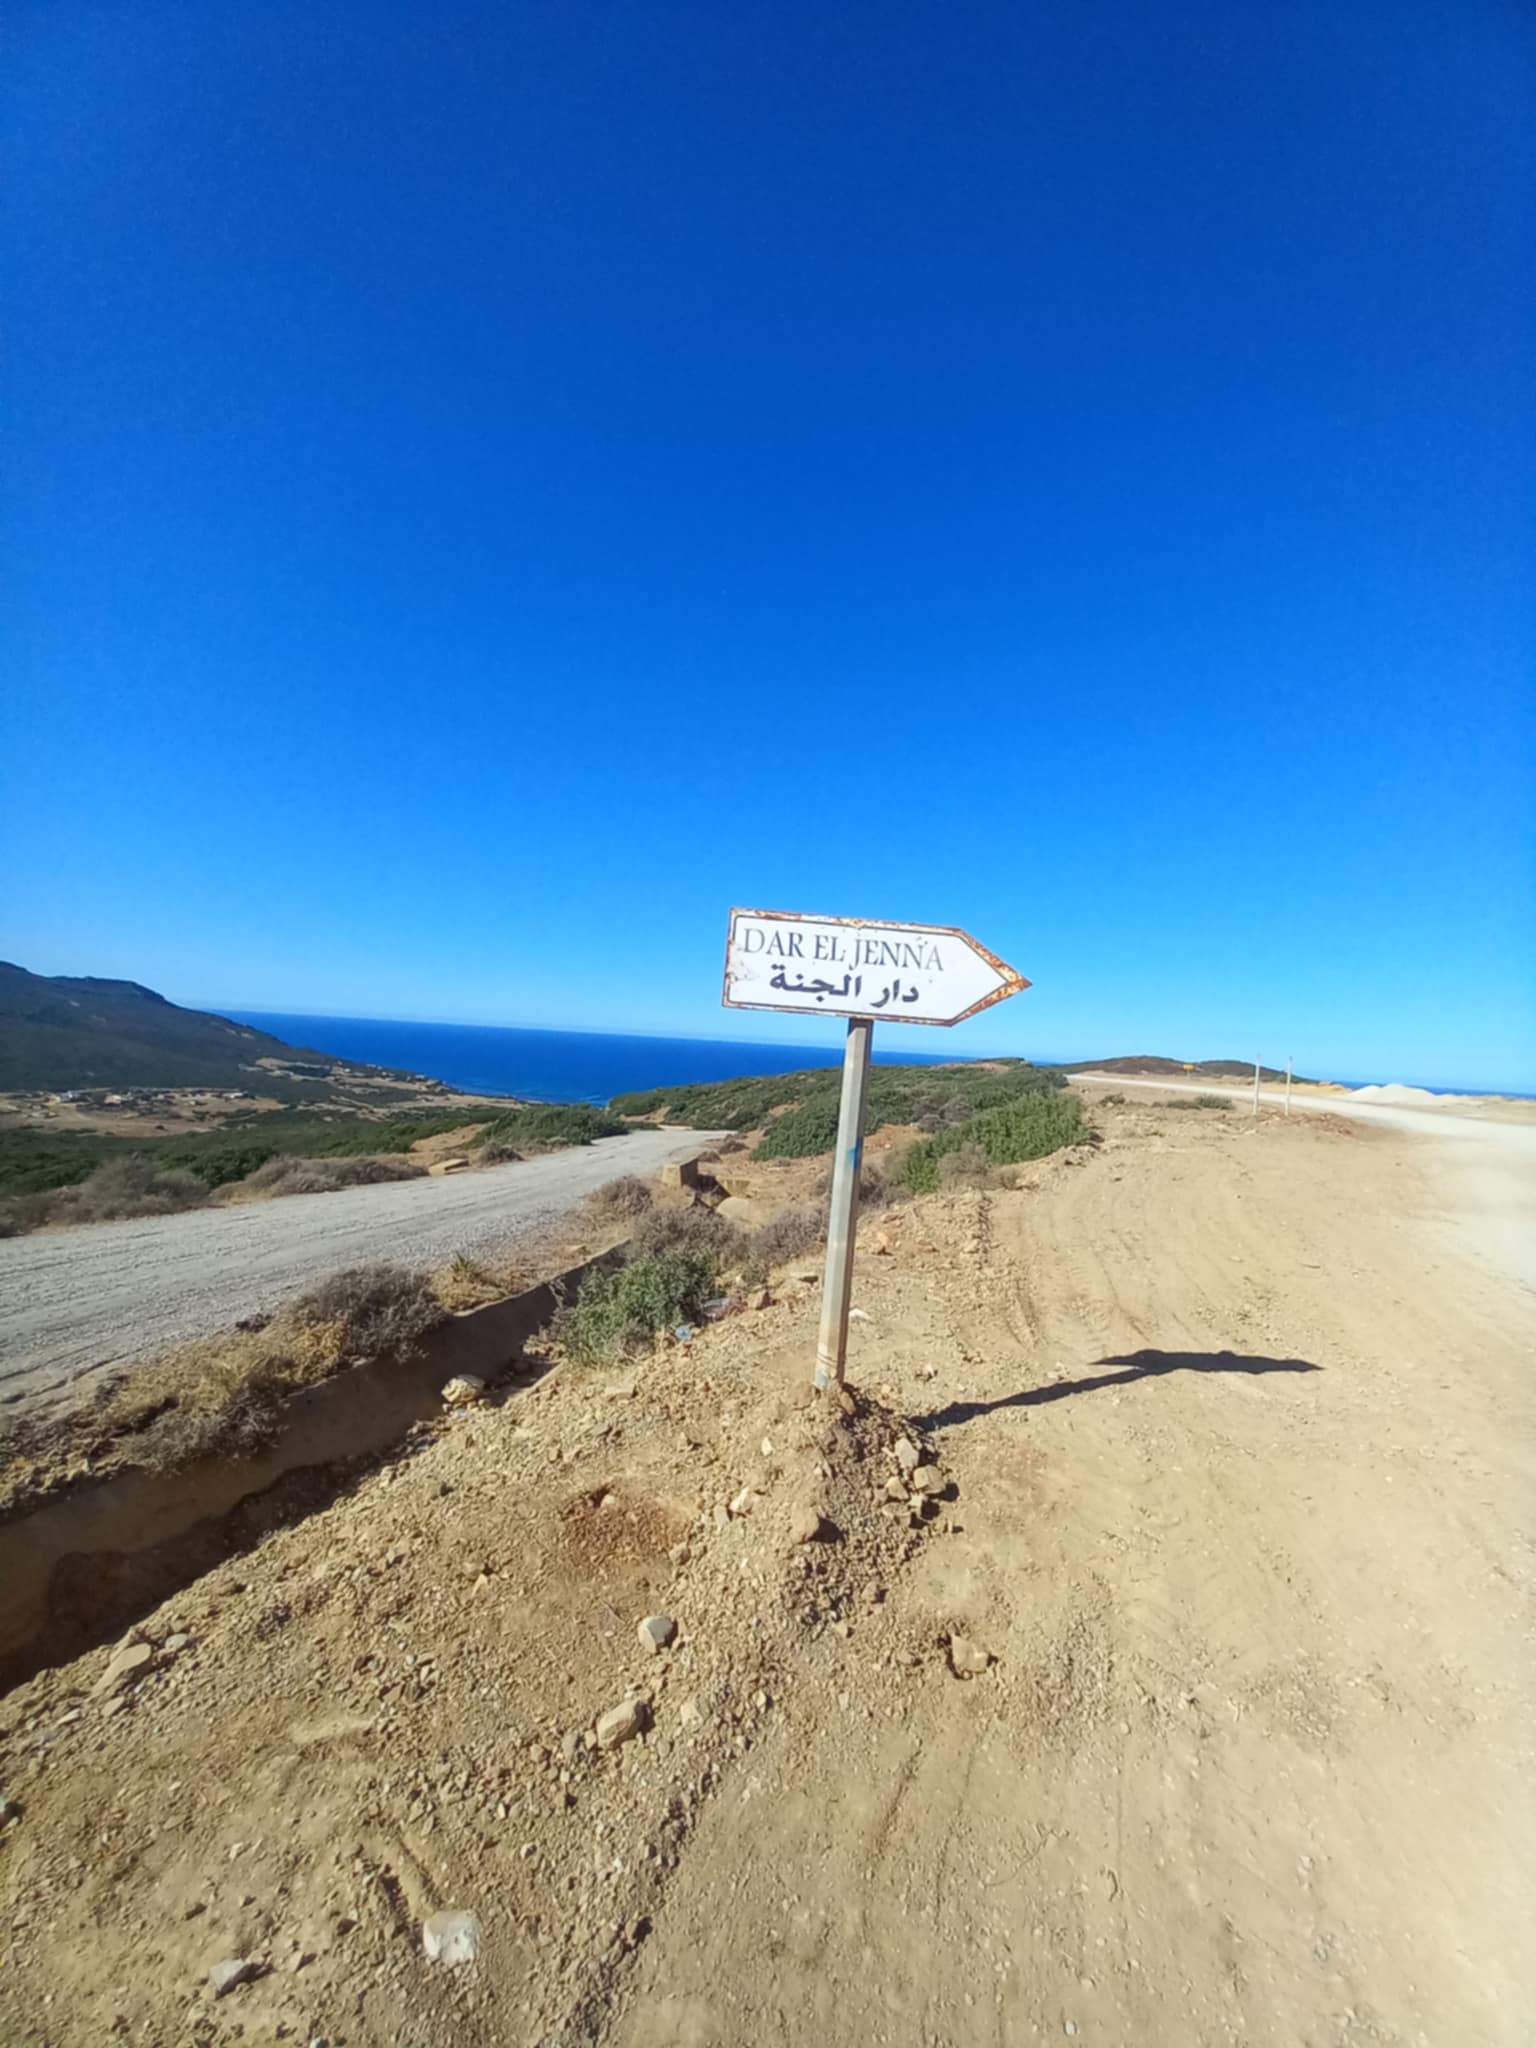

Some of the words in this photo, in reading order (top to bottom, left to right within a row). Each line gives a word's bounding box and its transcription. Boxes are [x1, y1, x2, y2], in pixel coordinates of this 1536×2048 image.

[743, 928, 805, 959] DAR
[813, 934, 847, 963] EL
[848, 937, 944, 972] JENNA
[769, 963, 863, 1002] الجنة
[870, 979, 920, 1008] دار
